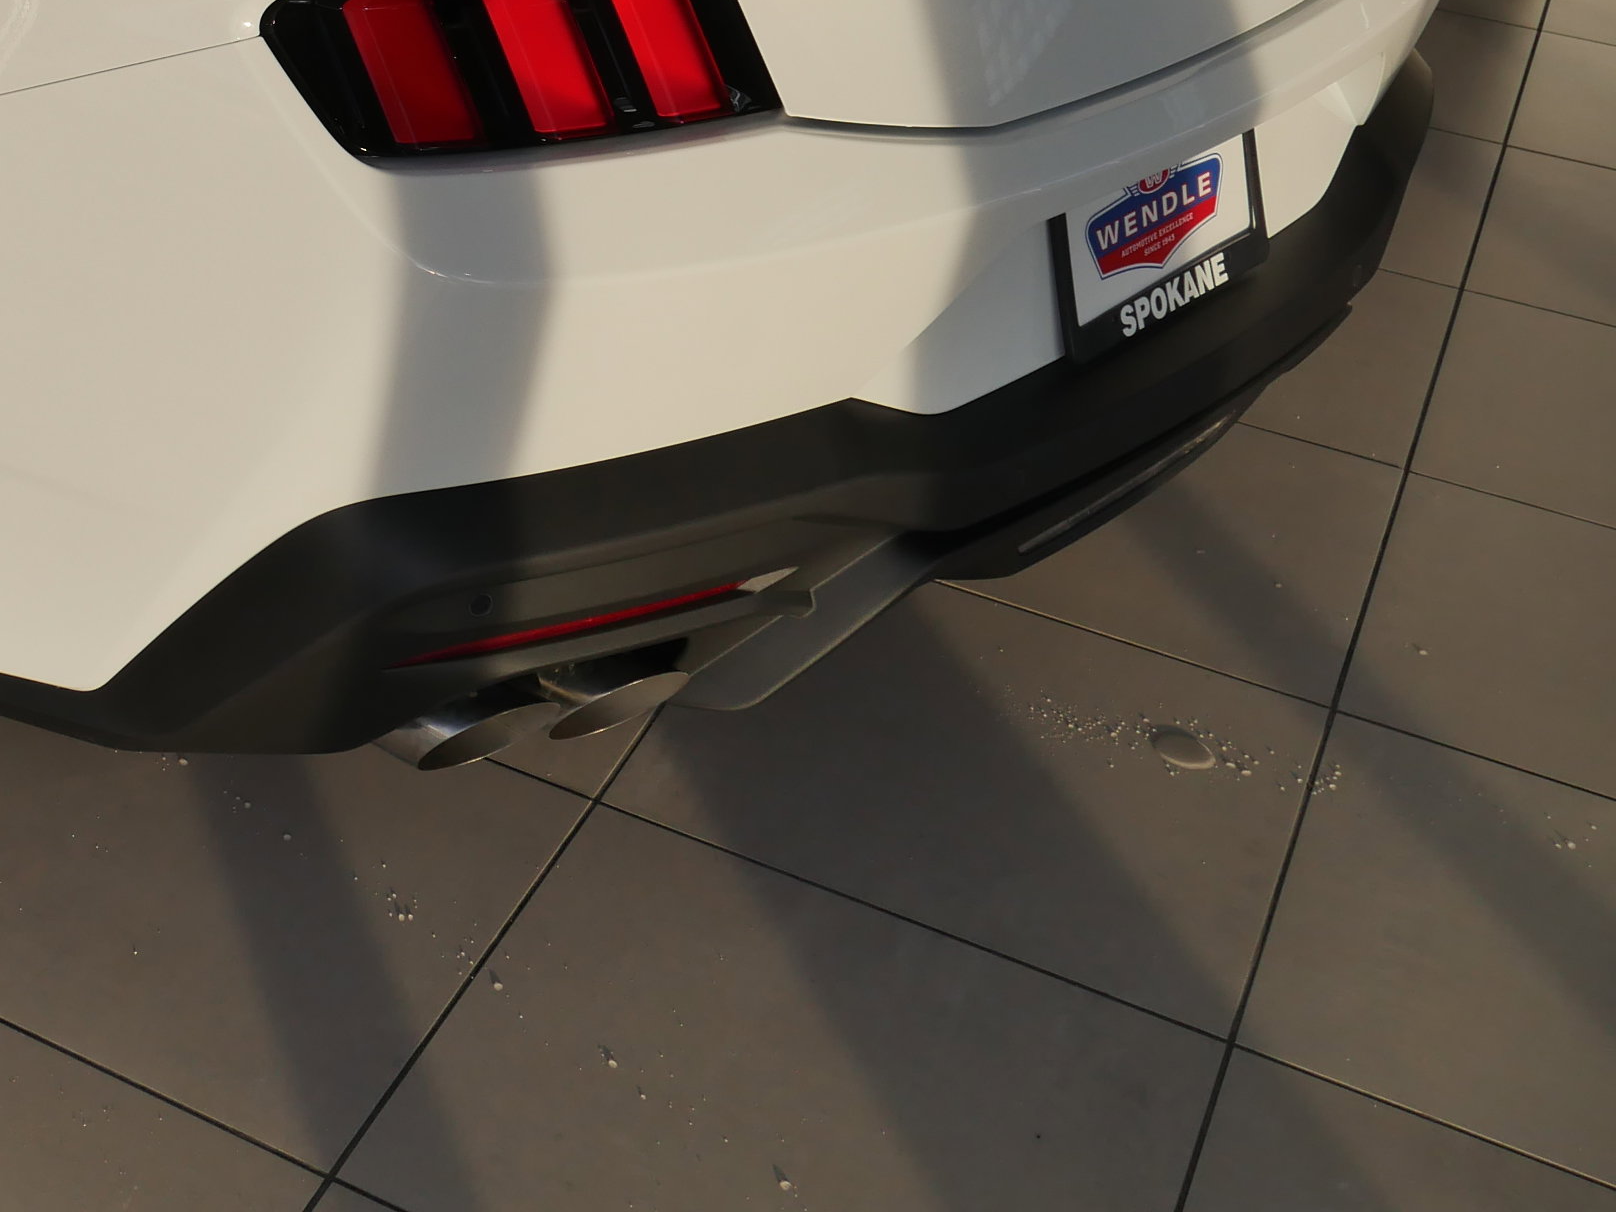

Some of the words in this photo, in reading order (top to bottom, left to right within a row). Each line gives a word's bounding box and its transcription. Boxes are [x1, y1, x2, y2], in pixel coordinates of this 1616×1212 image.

[1096, 171, 1212, 251] WENDLE
[1121, 232, 1158, 258] AUTOMOTIVE
[1159, 212, 1194, 236] EXCELLENCE
[1144, 241, 1162, 257] SINCE
[1120, 252, 1229, 337] SPOKANE
